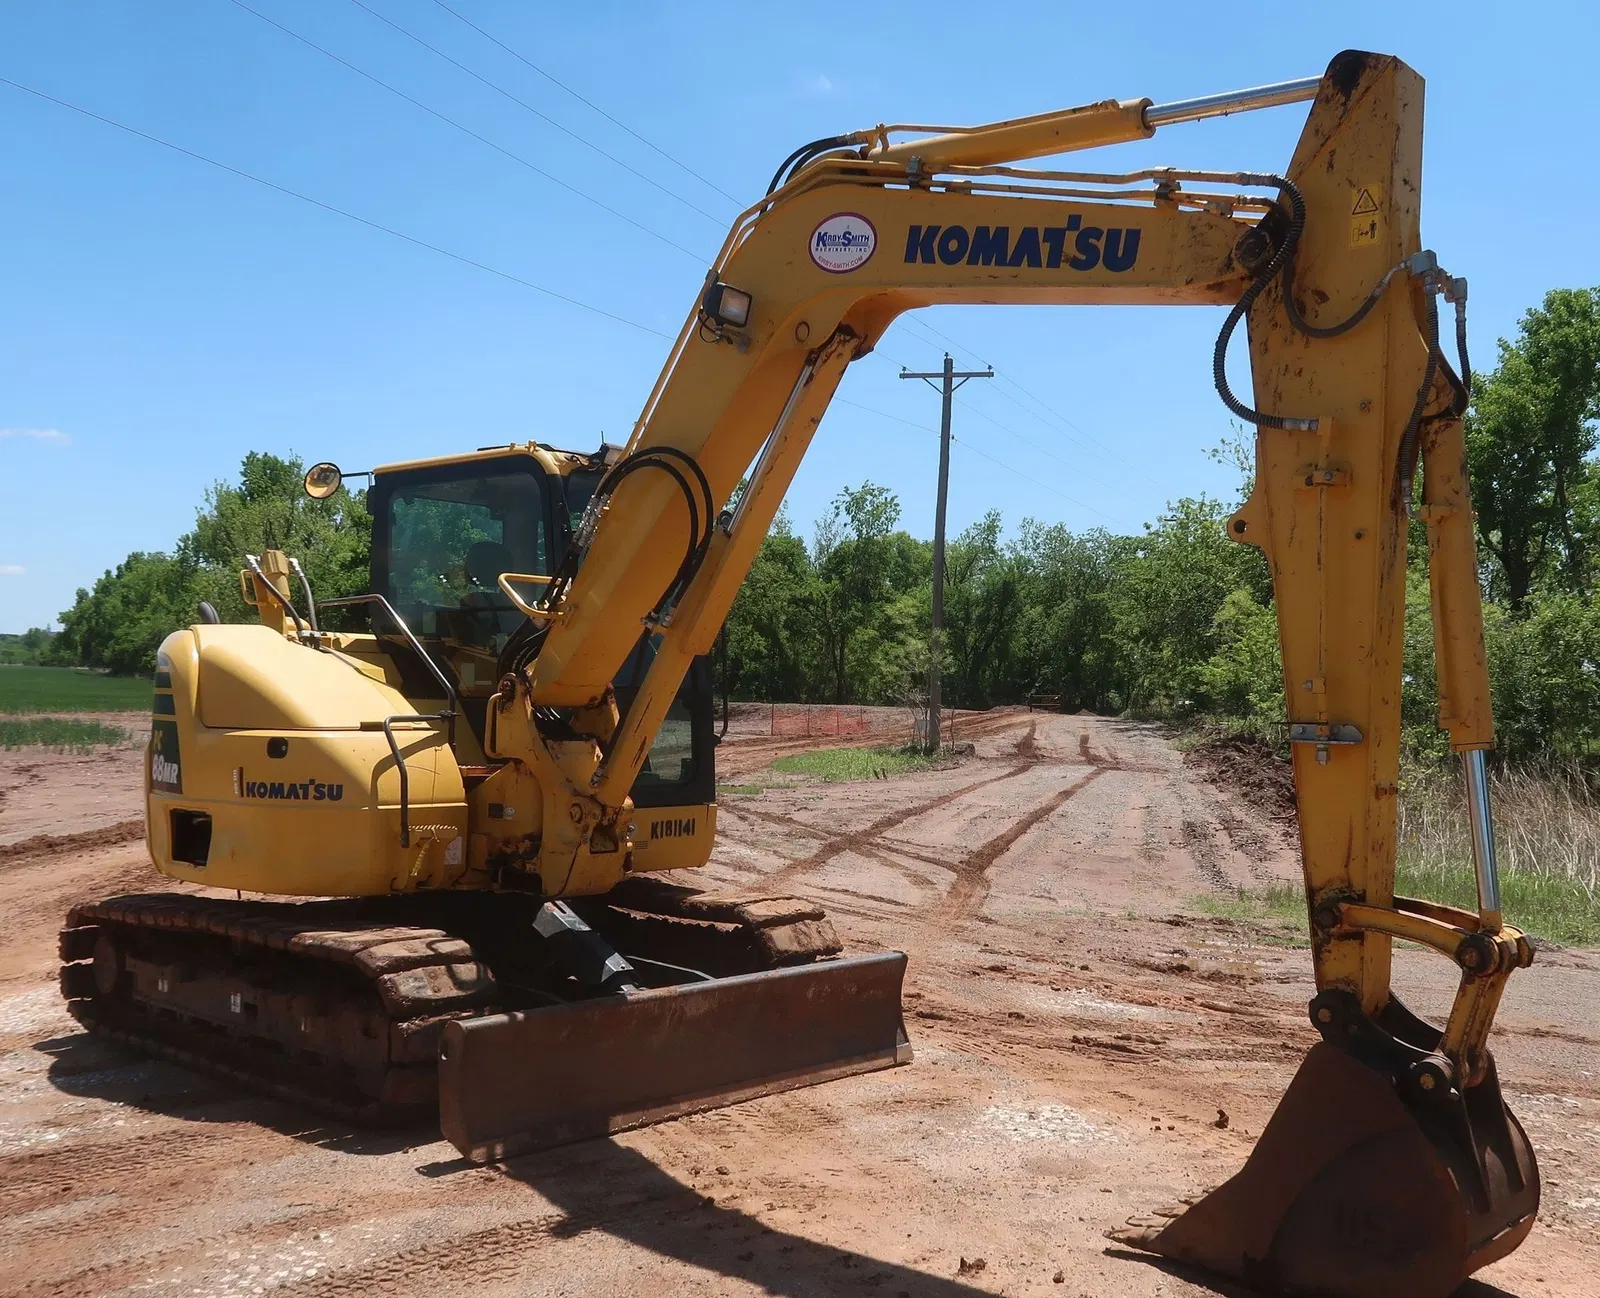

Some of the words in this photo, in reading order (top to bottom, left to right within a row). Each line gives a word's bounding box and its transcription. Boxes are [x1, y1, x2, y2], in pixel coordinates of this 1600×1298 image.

[904, 214, 1142, 272] KOMATSU
[246, 779, 343, 801] KOMATSU
[651, 818, 695, 839] K181141
